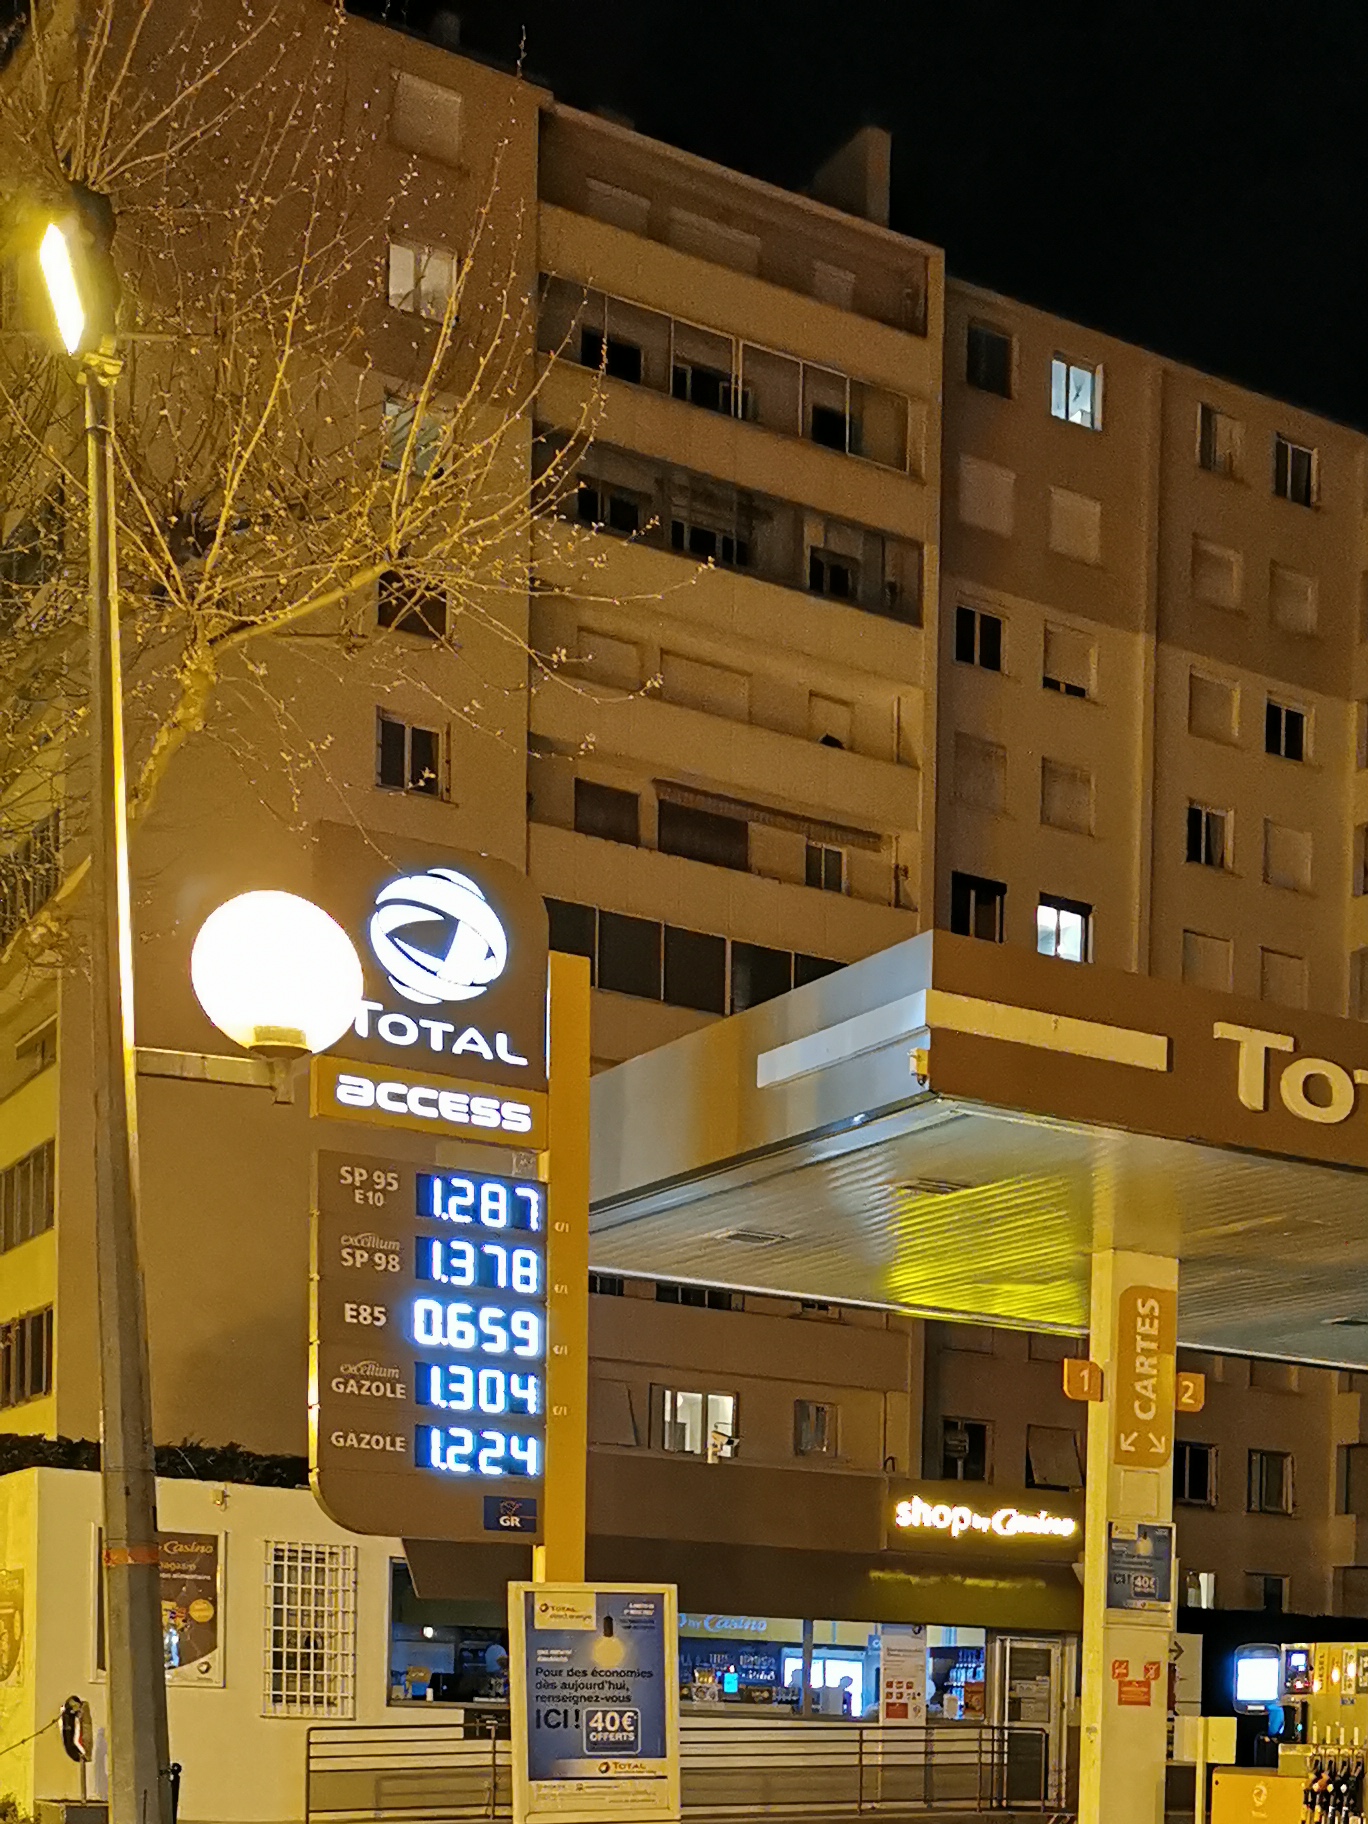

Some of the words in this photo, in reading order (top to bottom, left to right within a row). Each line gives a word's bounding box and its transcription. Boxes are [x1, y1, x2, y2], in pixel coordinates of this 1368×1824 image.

[353, 999, 529, 1066] TOTAL
[336, 1074, 533, 1132] access
[340, 1166, 368, 1186] SP
[372, 1170, 399, 1191] 95
[354, 1189, 384, 1207] E10
[432, 1177, 540, 1232] 1.287
[340, 1247, 369, 1268] SP
[373, 1252, 401, 1272] 98
[432, 1240, 539, 1295] 1.378
[343, 1302, 387, 1326] E85
[413, 1298, 540, 1358] 0.659
[1133, 1297, 1160, 1421] CARTES
[331, 1377, 407, 1400] GAZOLE
[429, 1365, 539, 1415] 1.304
[1079, 1367, 1093, 1392] 1
[1181, 1380, 1195, 1404] 2
[330, 1431, 406, 1453] GAZOLE
[429, 1426, 538, 1477] 1.224
[499, 1515, 522, 1527] GR
[896, 1495, 973, 1537] shop
[991, 1508, 1076, 1537] Casino
[164, 1540, 214, 1554] Casino
[703, 1613, 767, 1633] Casino
[535, 1667, 564, 1678] Pour
[566, 1667, 588, 1678] des
[591, 1667, 654, 1678] économies
[535, 1694, 632, 1705] renseignez-vous
[535, 1708, 569, 1730] ICI
[574, 1708, 581, 1729] !
[589, 1731, 636, 1742] OFFERTS
[613, 1761, 647, 1771] TOTAL
